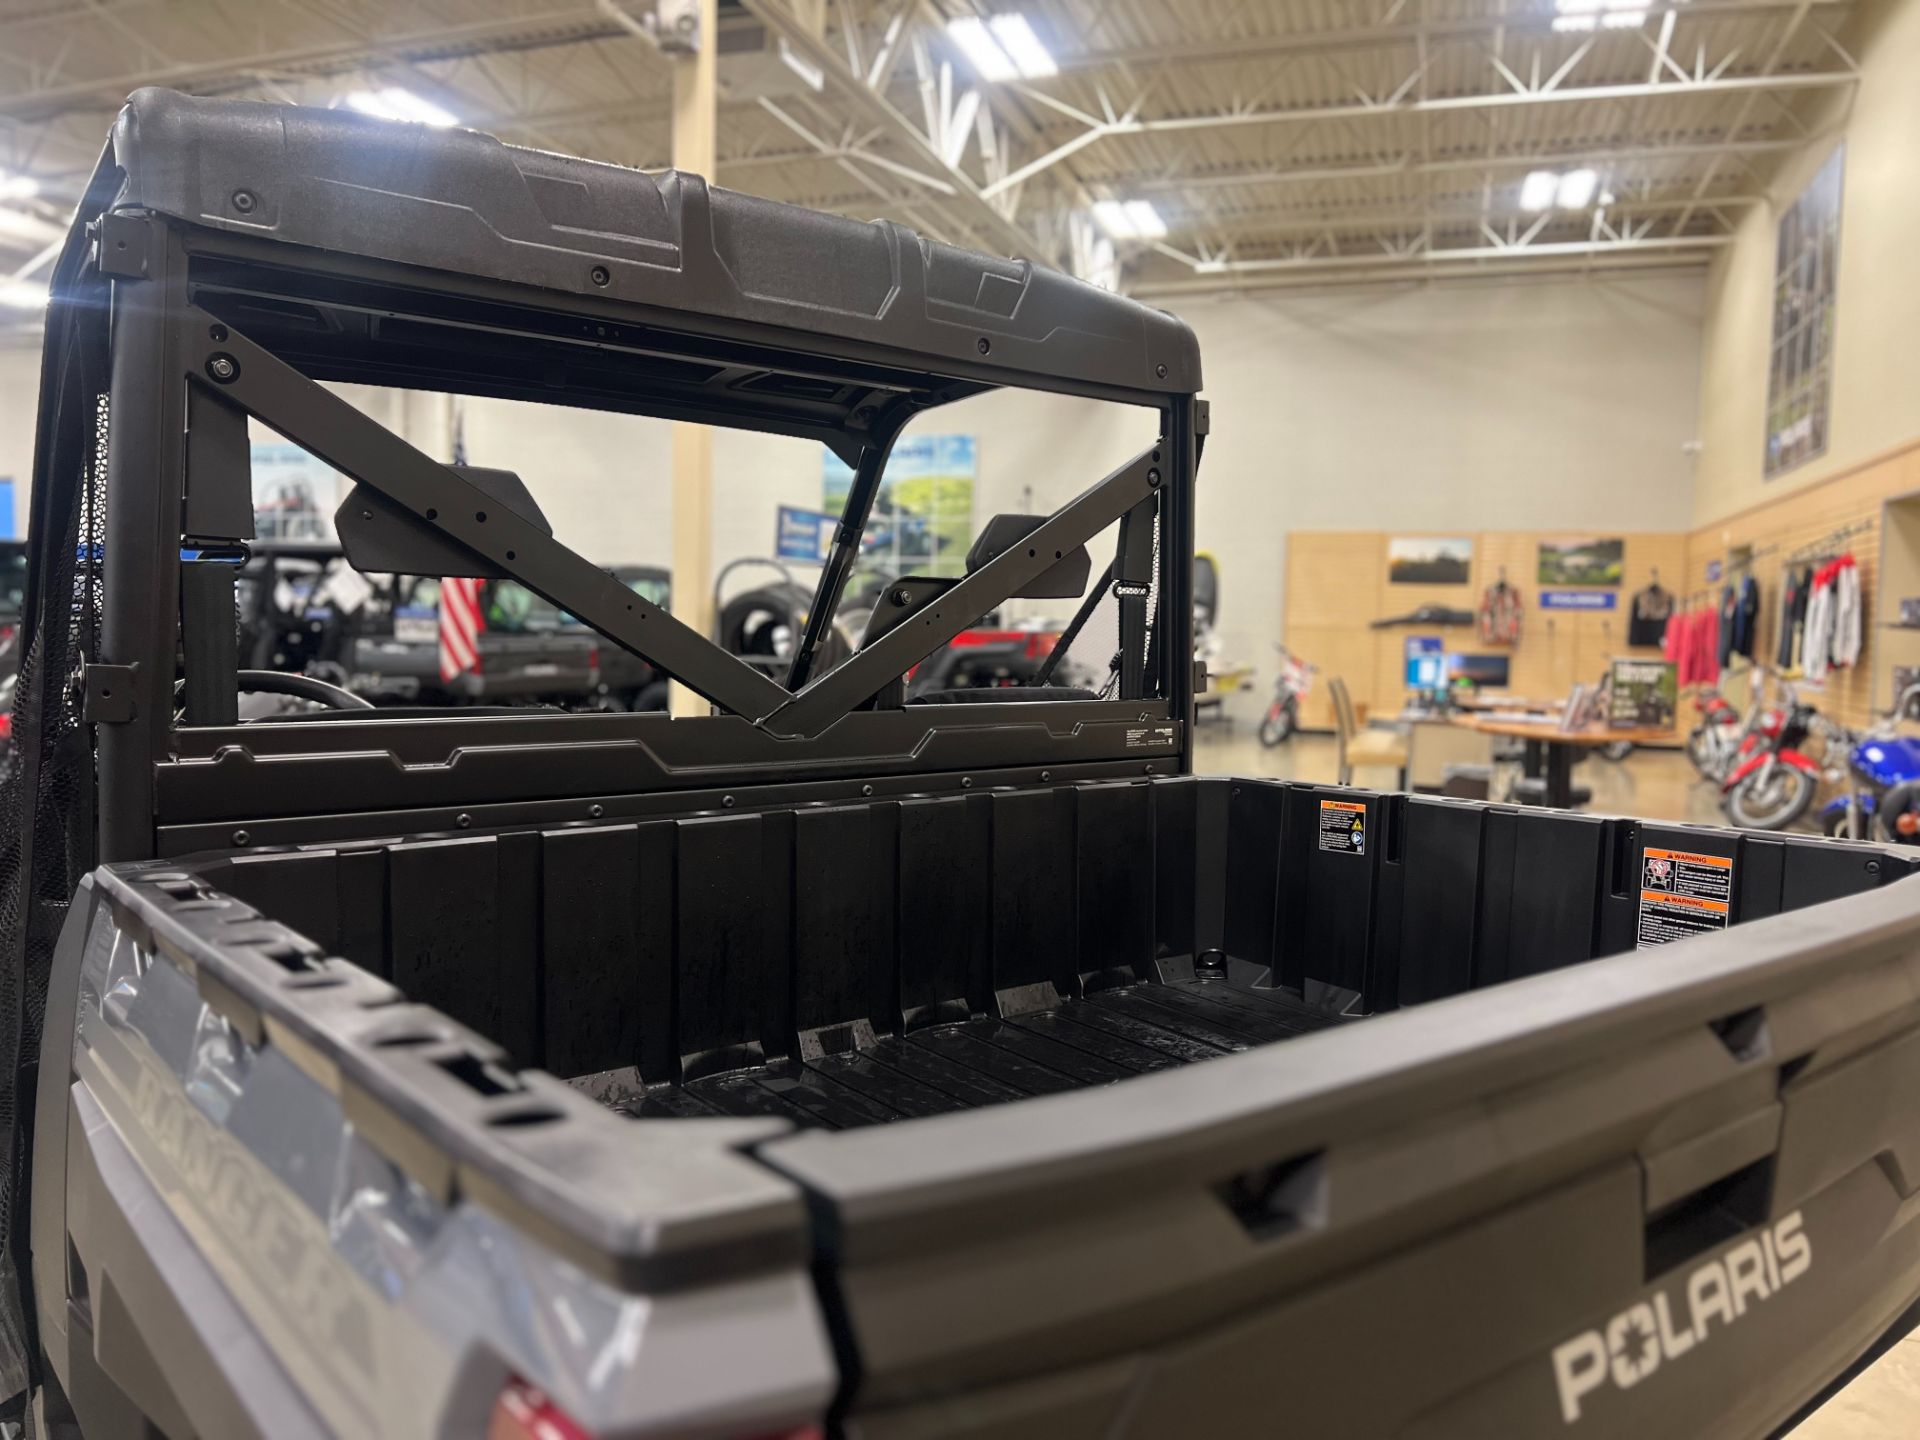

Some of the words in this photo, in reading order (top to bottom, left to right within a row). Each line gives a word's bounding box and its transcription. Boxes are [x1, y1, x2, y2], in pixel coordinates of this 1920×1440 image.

[1674, 854, 1707, 864] WARNING
[1671, 896, 1704, 907] WARNING
[1552, 1209, 1812, 1425] POLARIS
